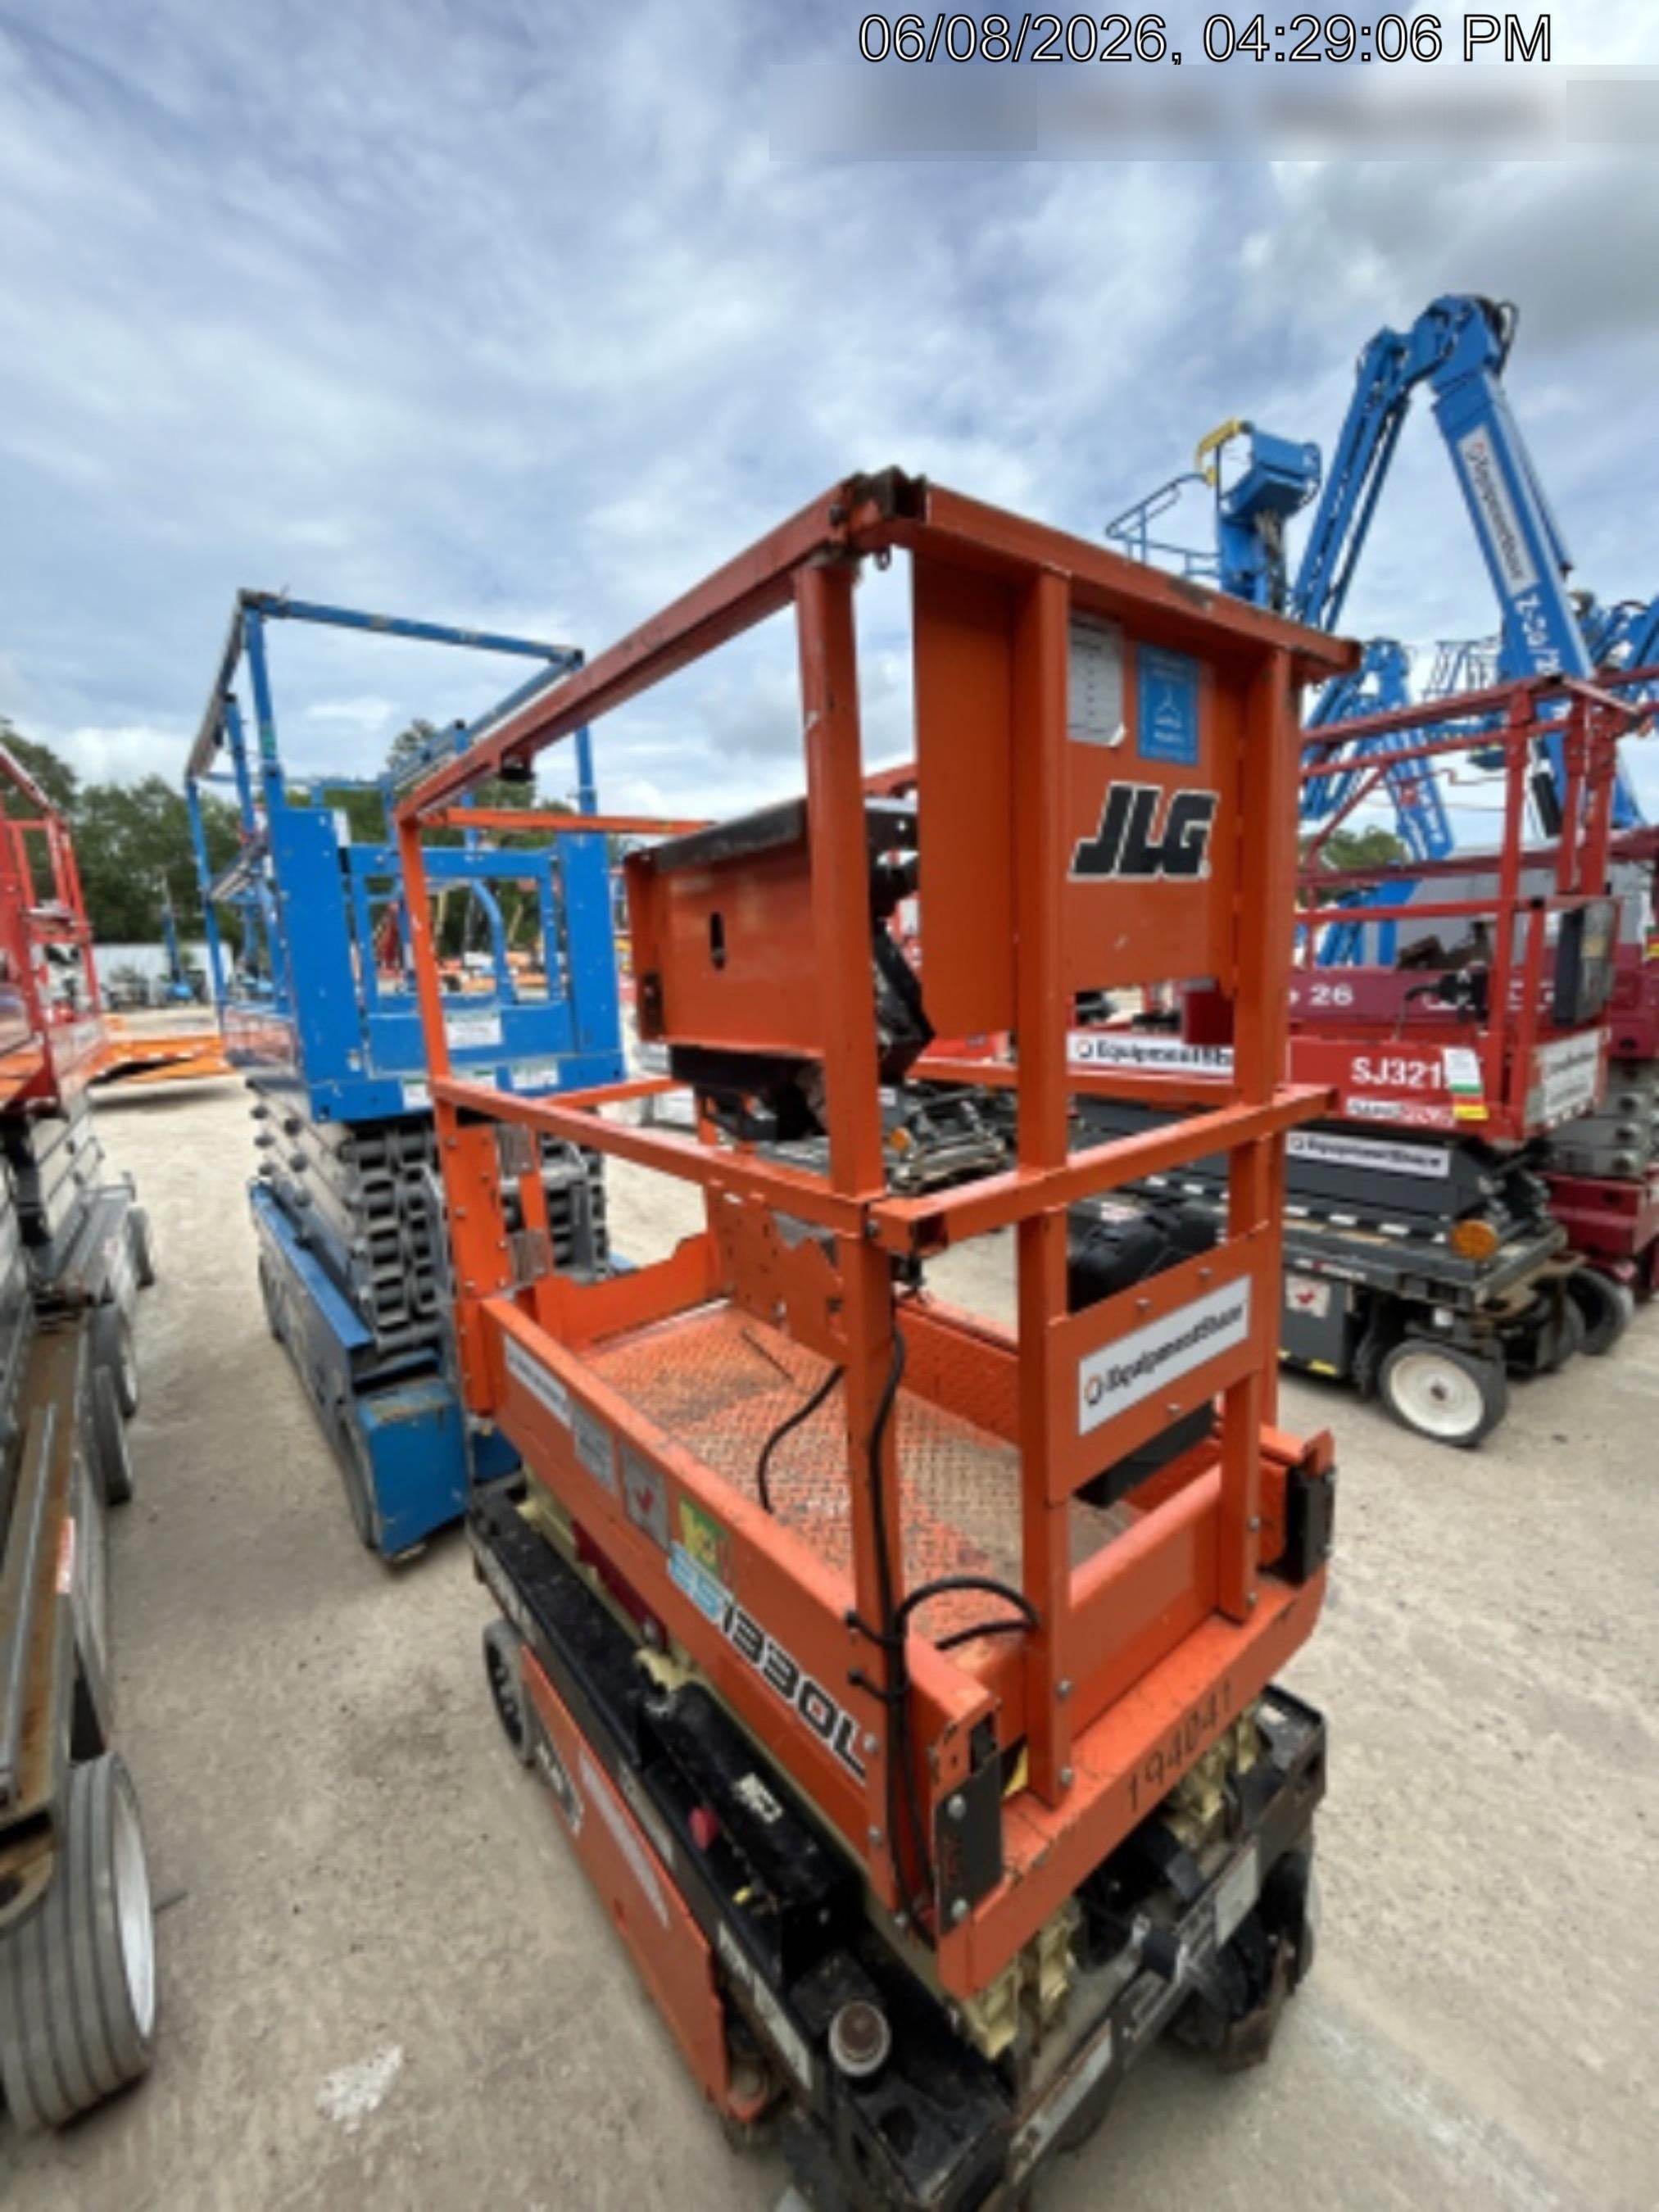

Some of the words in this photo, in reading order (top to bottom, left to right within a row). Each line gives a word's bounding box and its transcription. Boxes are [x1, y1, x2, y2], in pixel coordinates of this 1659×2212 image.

[1067, 781, 1219, 882] JLG
[1308, 983, 1353, 1006] 26
[1352, 1057, 1447, 1090] SJ321
